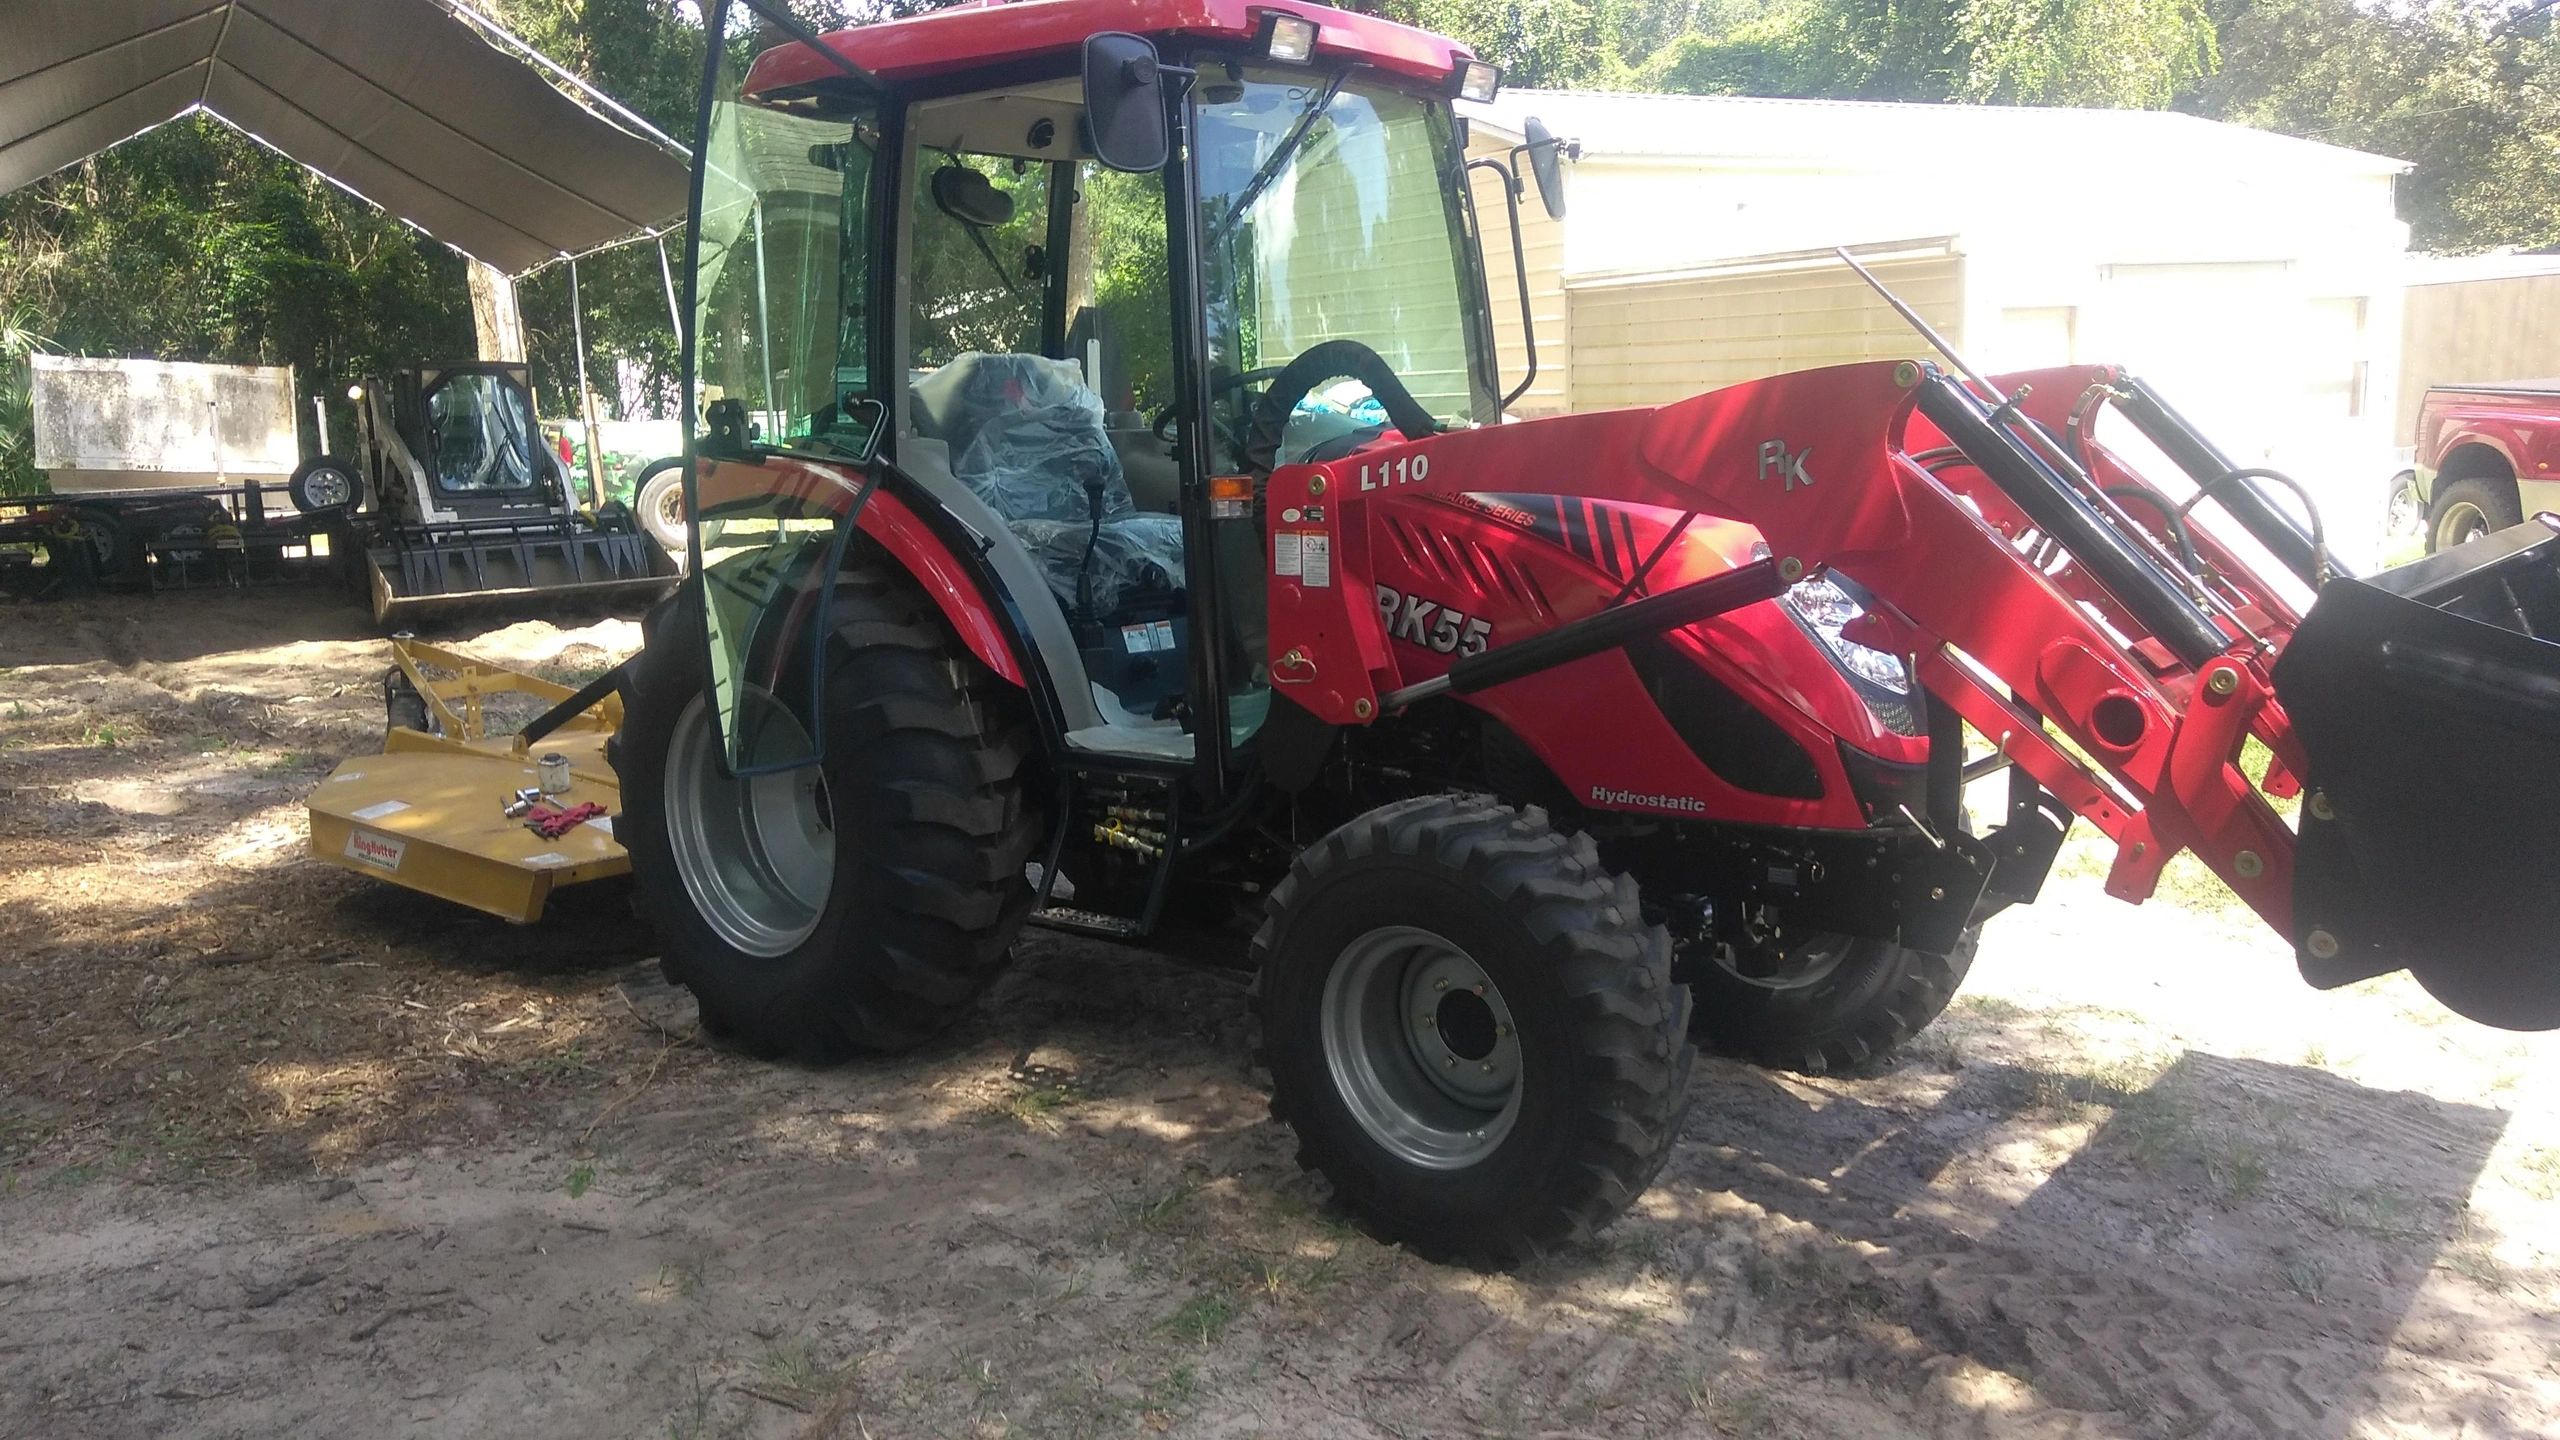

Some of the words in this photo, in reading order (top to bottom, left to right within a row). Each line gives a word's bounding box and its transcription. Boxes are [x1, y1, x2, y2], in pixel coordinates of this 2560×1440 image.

[1361, 454, 1428, 491] L110
[1759, 439, 1814, 491] RK
[1484, 503, 1537, 527] SERIES
[1376, 583, 1492, 658] RK55
[1591, 785, 1706, 812] Hydrostatic
